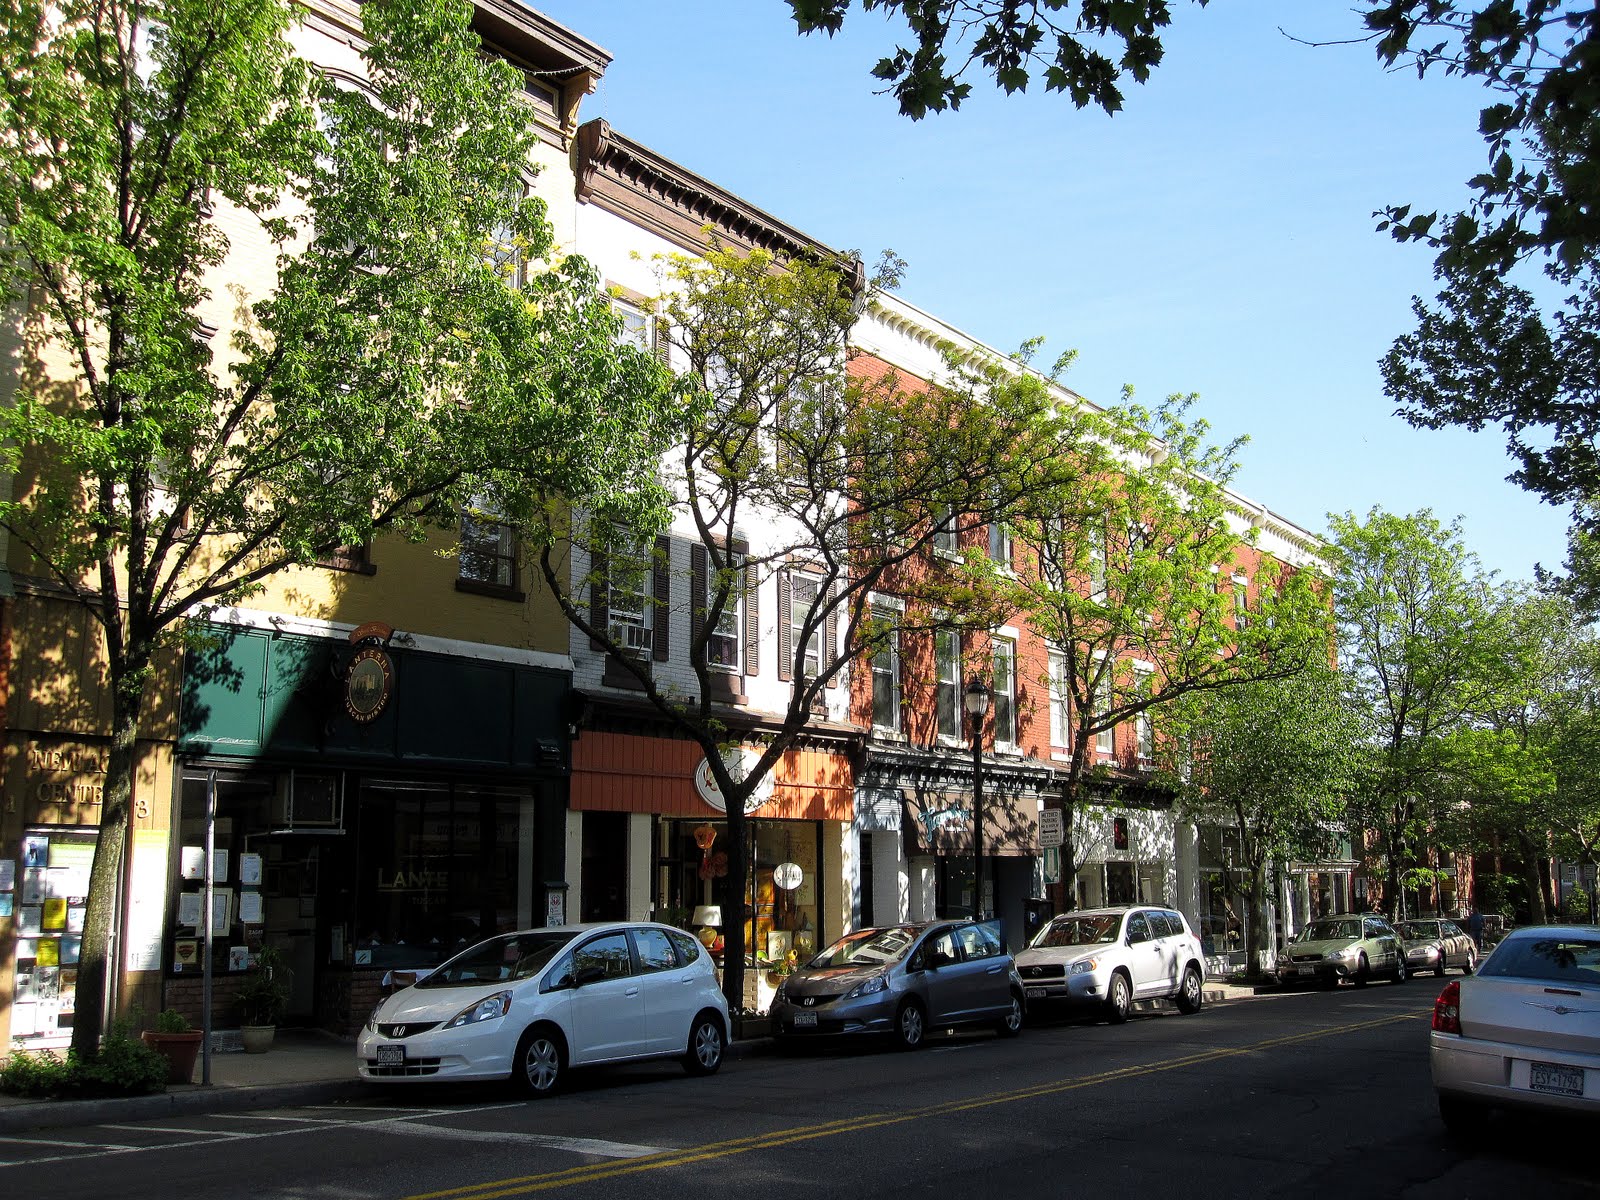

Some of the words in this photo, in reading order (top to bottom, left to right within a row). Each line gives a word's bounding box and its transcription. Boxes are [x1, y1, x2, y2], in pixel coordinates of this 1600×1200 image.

[345, 650, 390, 684] LANTERNA
[345, 696, 364, 722] TUSCAN
[366, 693, 388, 721] BISTRO
[32, 749, 81, 772] NEW
[87, 753, 109, 774] AG
[36, 783, 103, 805] CENTE
[136, 800, 150, 819] 3
[1030, 912, 1036, 922] P
